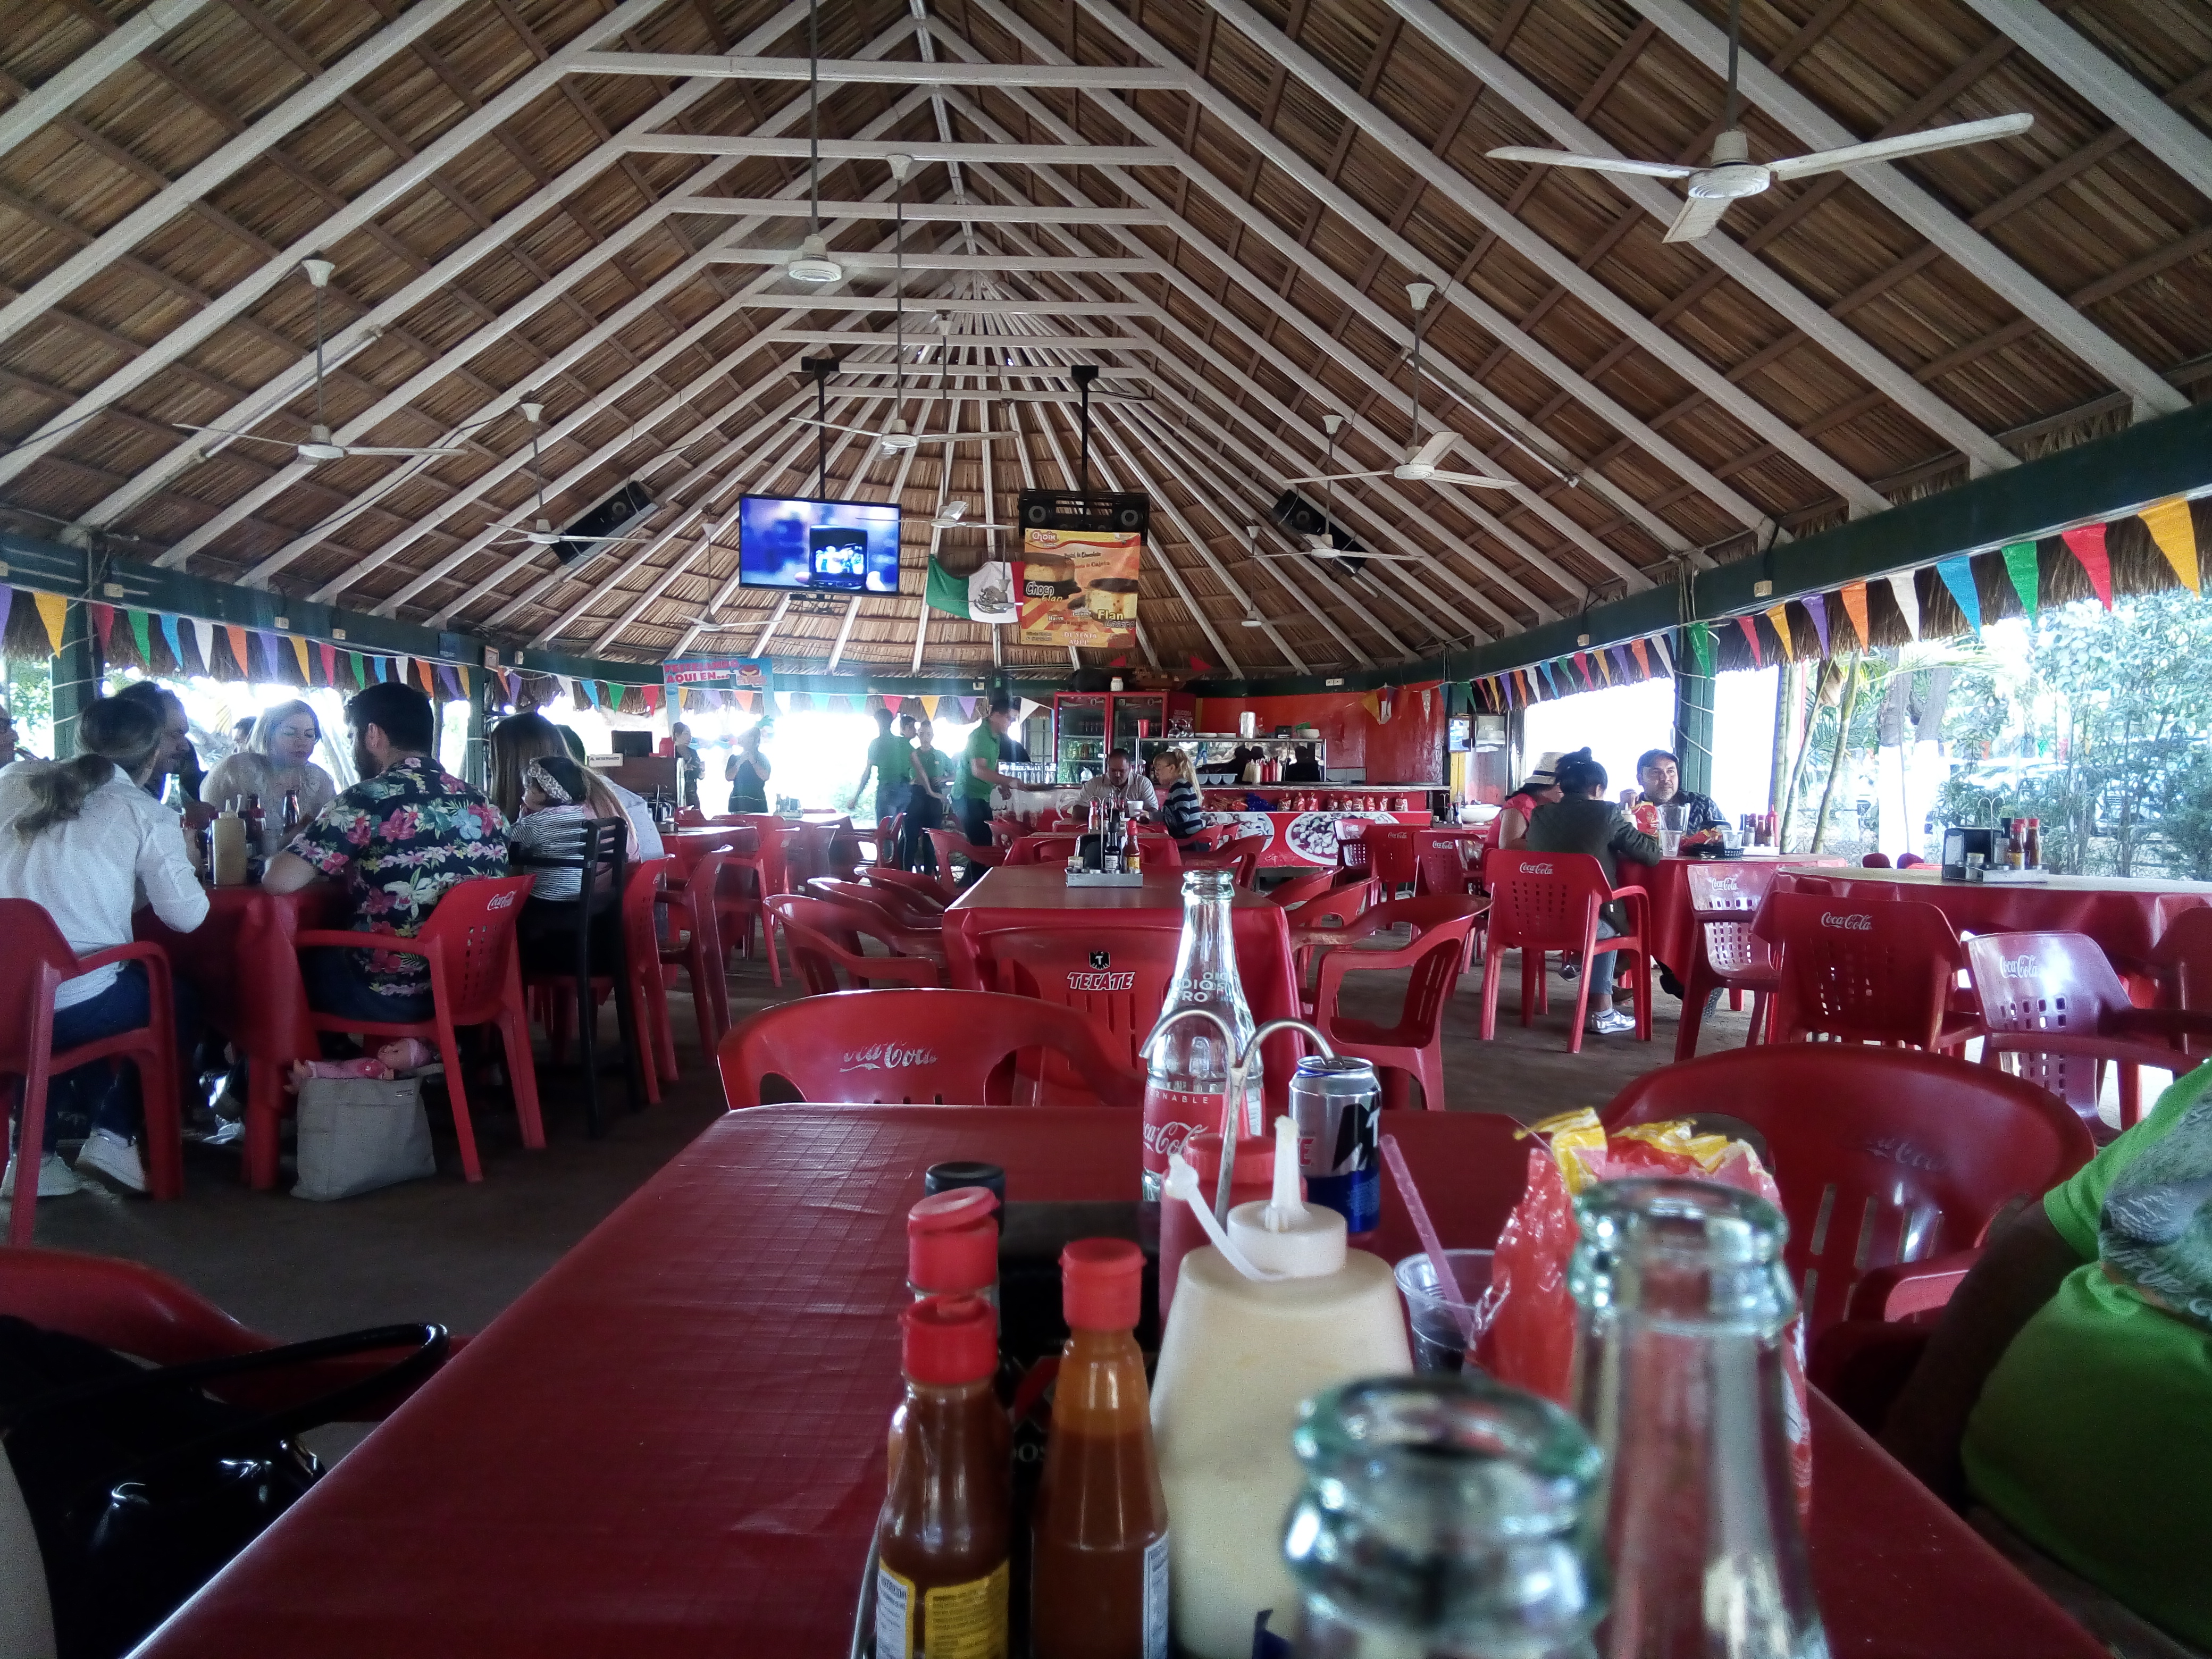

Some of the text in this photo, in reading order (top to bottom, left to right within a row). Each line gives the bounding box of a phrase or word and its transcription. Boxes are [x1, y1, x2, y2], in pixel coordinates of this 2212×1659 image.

[1032, 531, 1056, 541] Choix
[1026, 581, 1054, 596] Choco
[1041, 593, 1063, 602] Flan
[1097, 609, 1124, 621] Flan
[666, 673, 697, 683] AQUI
[700, 672, 730, 681] EN...
[1519, 862, 1553, 875] Coca-Cola
[1821, 911, 1872, 930] Coca-Cola
[1095, 956, 1103, 965] T
[2000, 955, 2039, 978] Coca-Cola
[1067, 971, 1136, 991] TECATE
